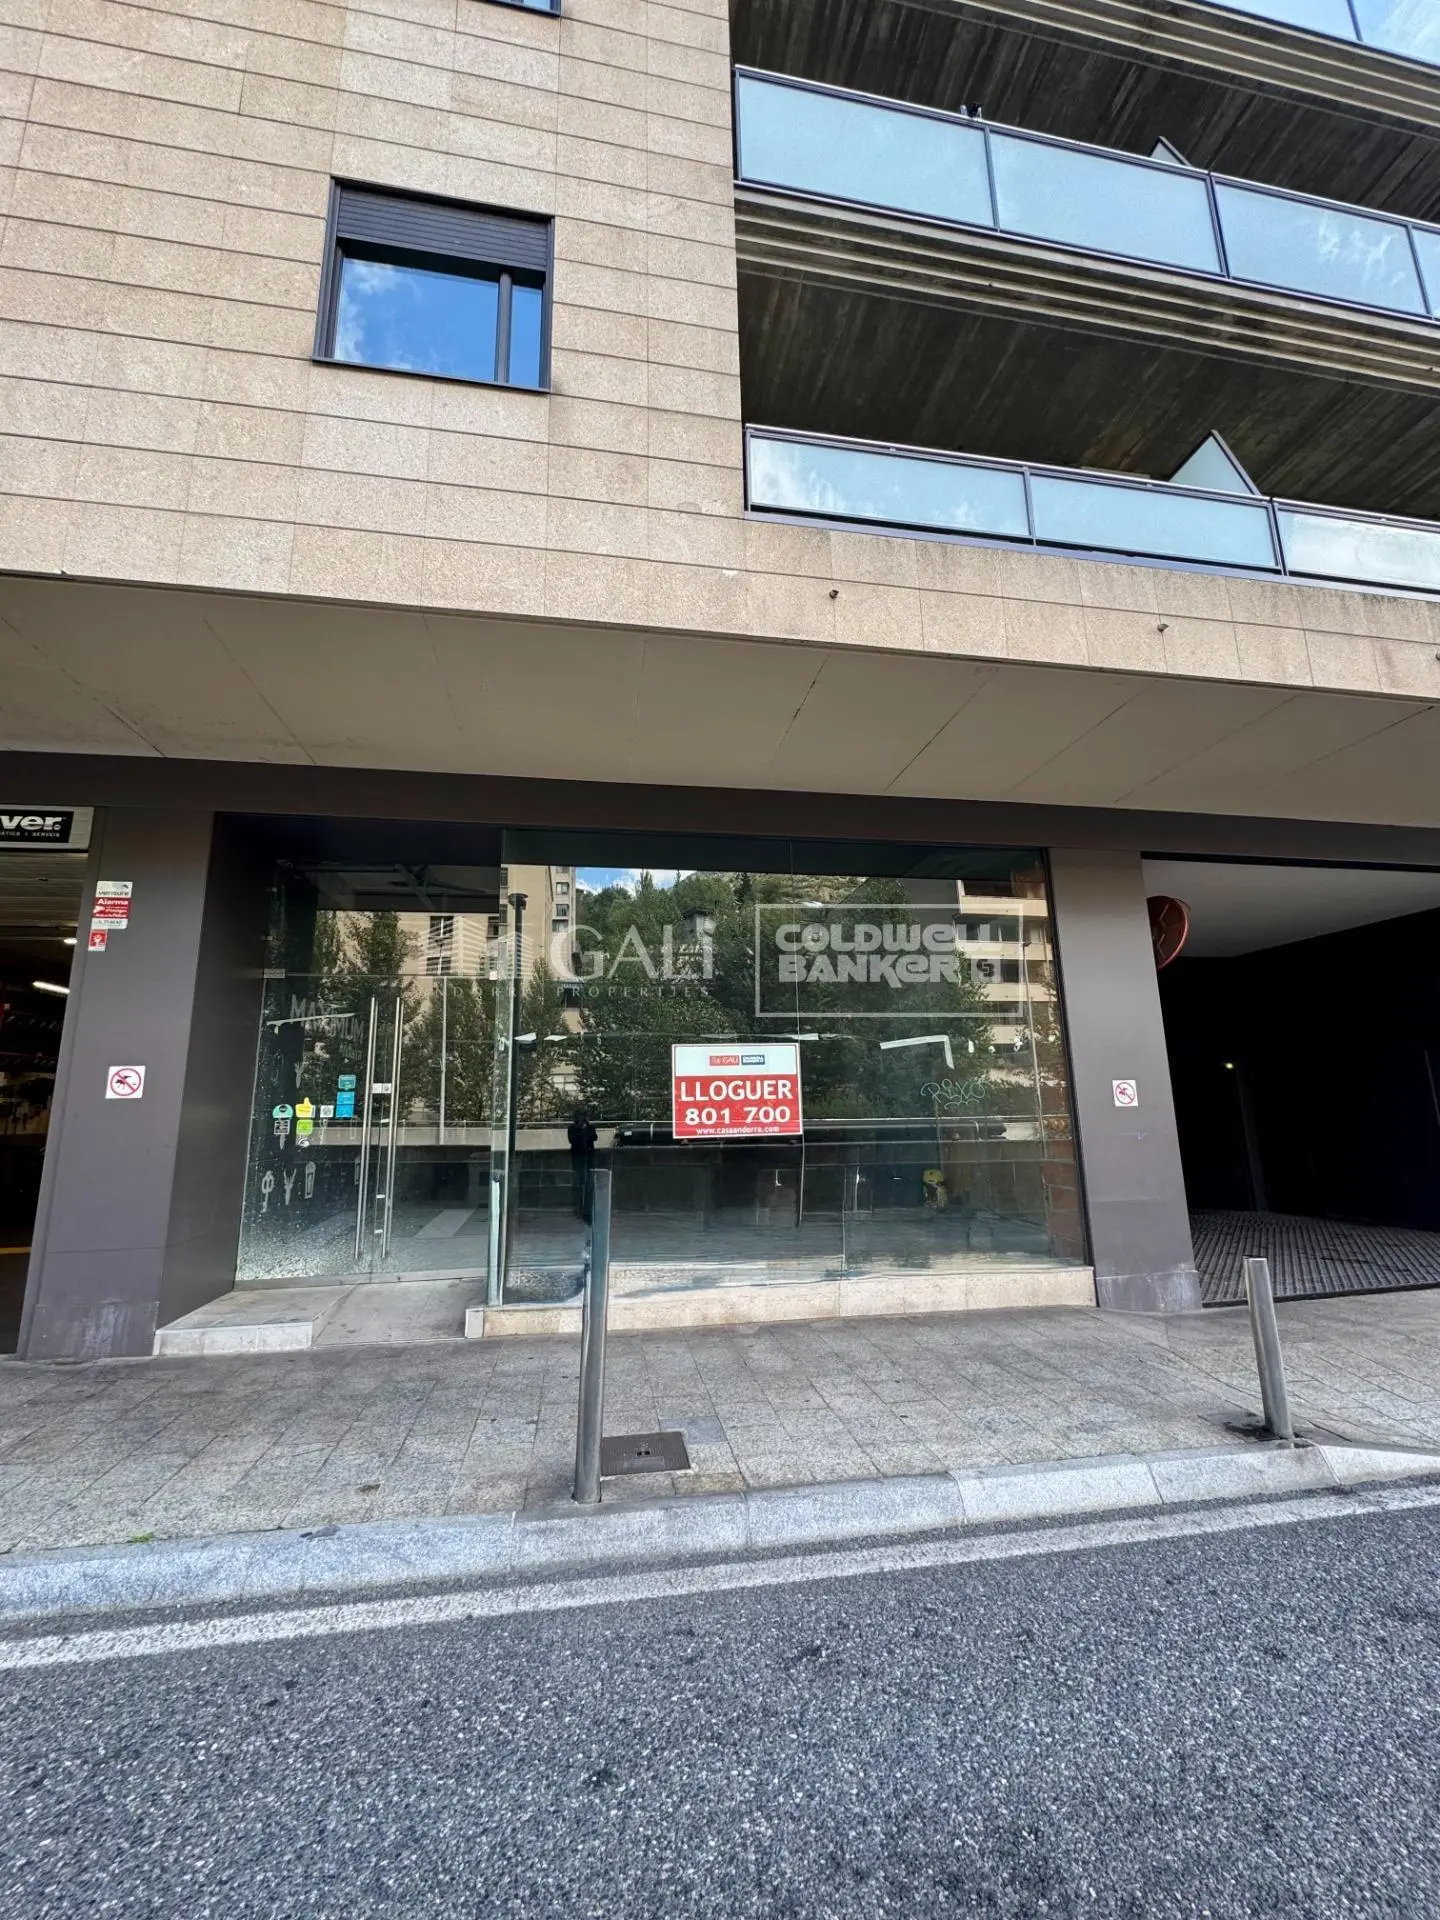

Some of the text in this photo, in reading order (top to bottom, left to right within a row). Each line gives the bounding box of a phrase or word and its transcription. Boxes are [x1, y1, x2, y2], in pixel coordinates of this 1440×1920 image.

[680, 1080, 793, 1102] LLOGUER
[684, 1106, 791, 1126] 801 700
[696, 1126, 780, 1134] www.casaandorra.com
